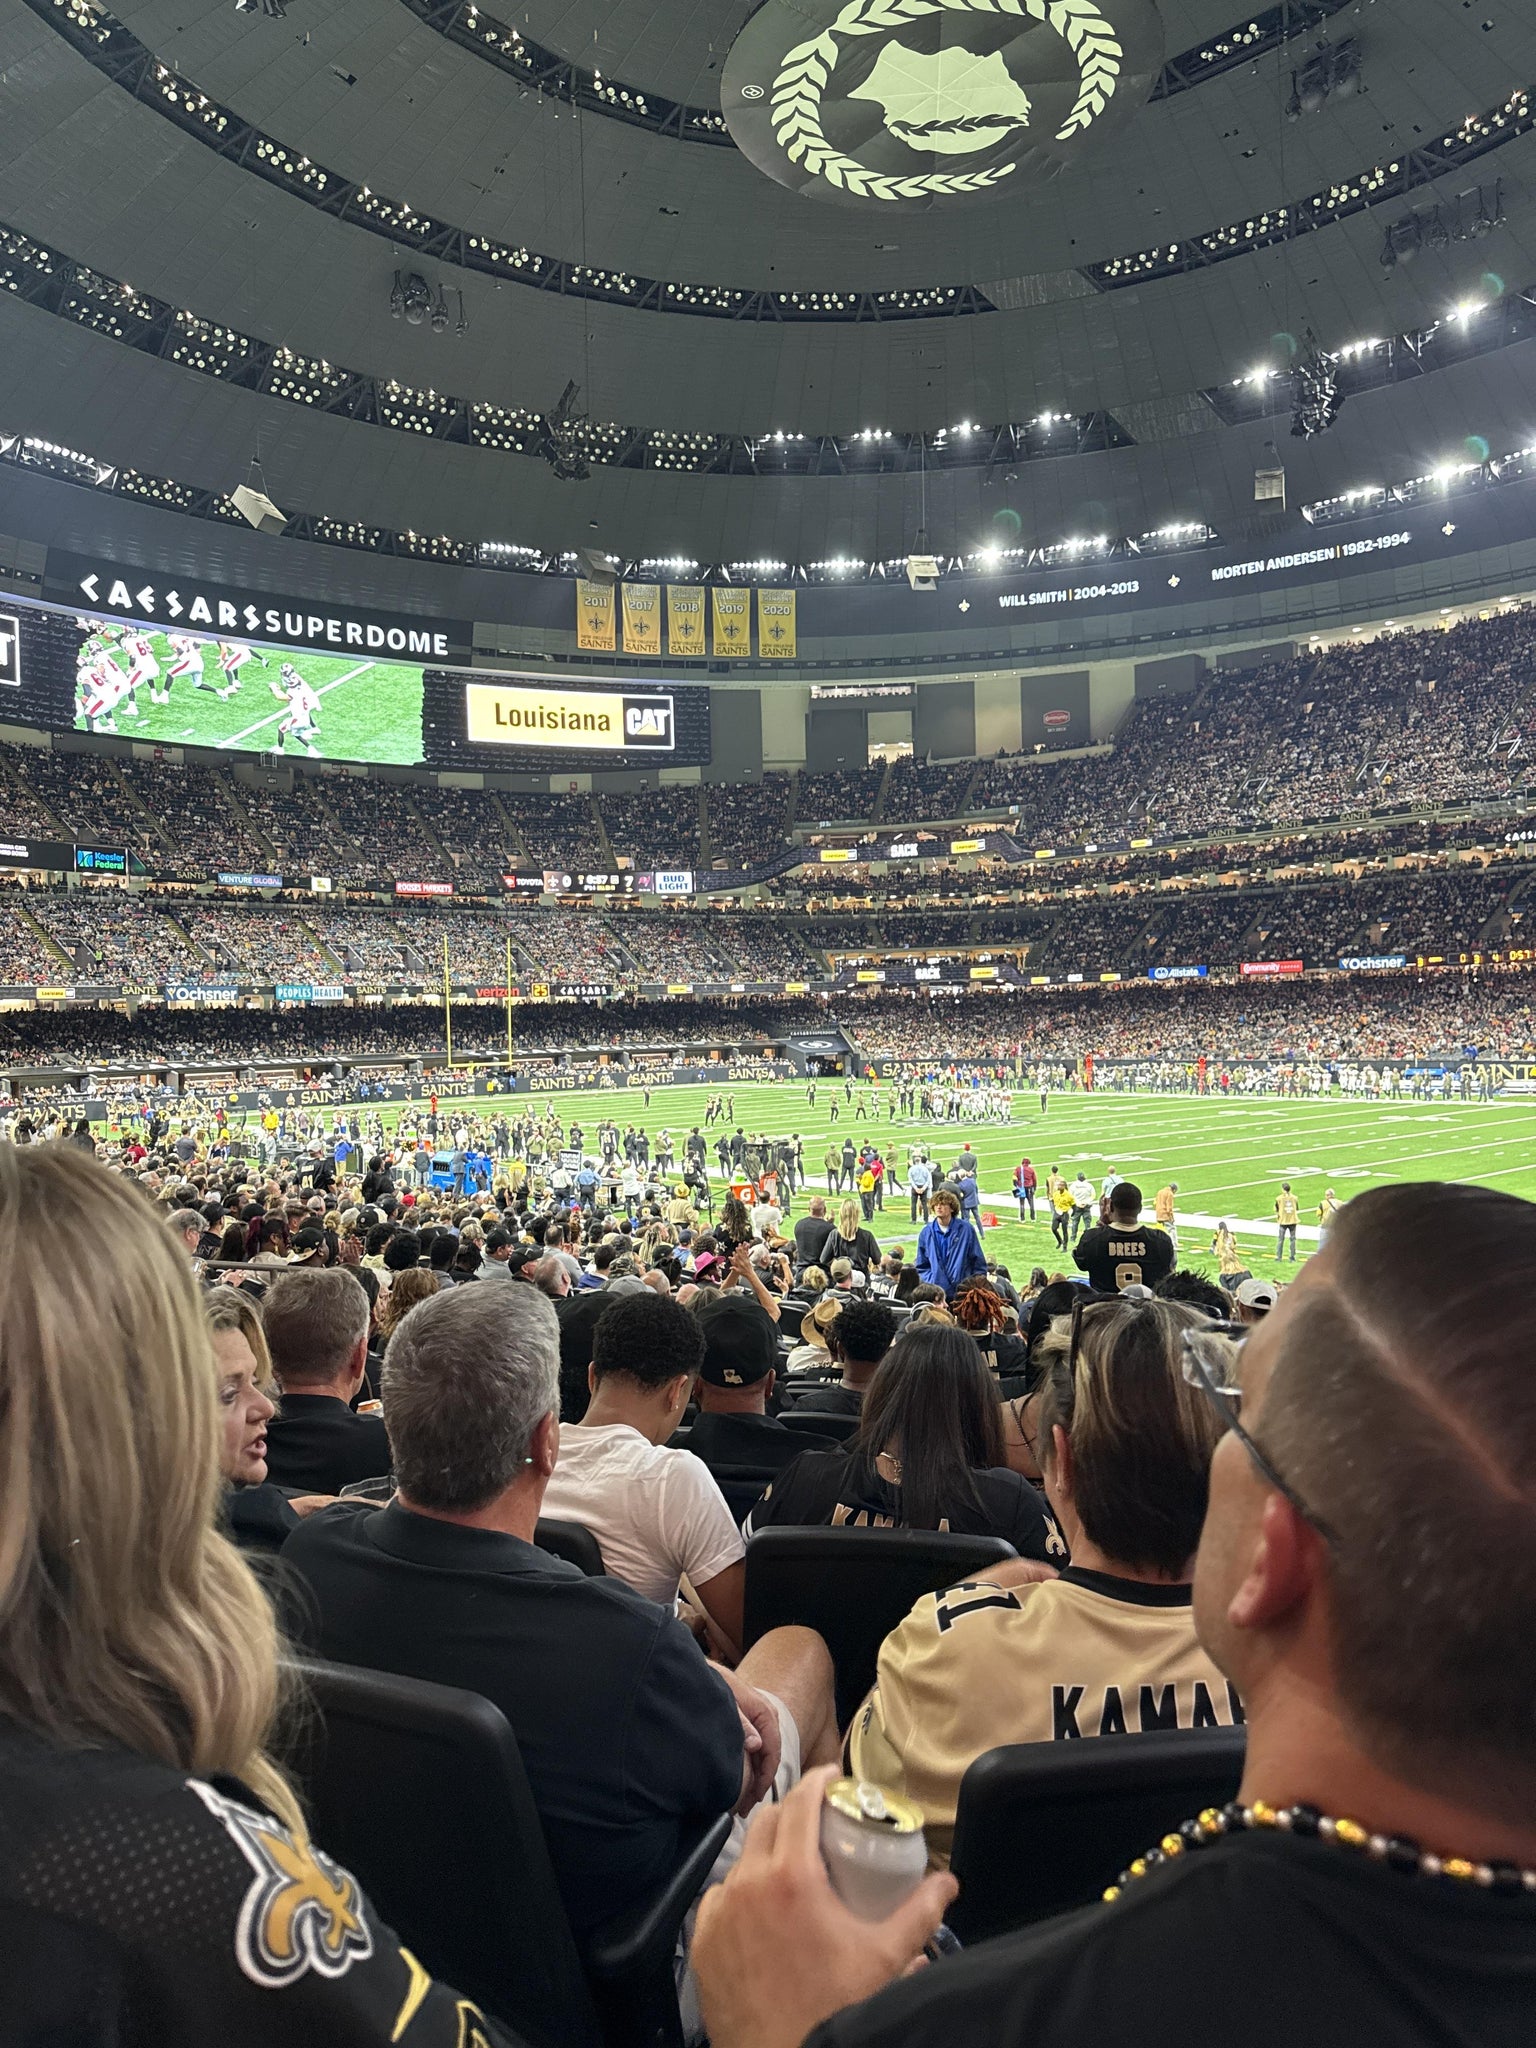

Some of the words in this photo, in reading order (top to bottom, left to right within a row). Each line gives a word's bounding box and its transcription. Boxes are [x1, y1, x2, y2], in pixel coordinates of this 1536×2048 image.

[1211, 560, 1265, 581] MORTEN
[1266, 547, 1335, 571] ANDERSEN
[1342, 531, 1411, 557] 1982-1994
[999, 594, 1028, 607] WILL
[1029, 591, 1067, 605] SMITH
[1074, 580, 1140, 600] 2004-2013
[584, 597, 608, 608] 2011
[629, 600, 654, 611] 2017
[673, 602, 699, 612] 2018
[80, 574, 260, 631] CAESARS
[265, 609, 449, 656] SUPERDOME
[719, 604, 744, 615] 2019
[763, 606, 791, 616] 2020
[580, 639, 613, 650] SAINTS
[625, 643, 658, 653] SAINTS
[671, 645, 703, 654] SAINTS
[716, 646, 748, 656] SAINTS
[761, 647, 794, 657] SAINTS
[495, 702, 611, 731] Louisiana
[626, 708, 669, 735] CAT
[1411, 802, 1444, 813] SAINTS
[1340, 811, 1371, 822] SAINTS
[94, 851, 124, 861] Keesler
[95, 860, 124, 870] Federal
[176, 871, 207, 880] SAINTS
[219, 875, 252, 885] VENTURE
[253, 876, 281, 885] GLOBAL
[562, 874, 572, 888] 0
[338, 879, 366, 888] SAINTS
[516, 878, 544, 886] TOYOTA
[624, 875, 634, 888] 7
[659, 883, 689, 891] LIGHT
[459, 885, 485, 893] SAINTS
[1349, 957, 1403, 970] Ochsner
[1168, 967, 1200, 977] Allstate
[122, 986, 158, 995] SAINTS
[176, 987, 237, 1000] Ochsner
[278, 987, 311, 998] PEOPLES
[314, 987, 342, 997] HEALTH
[356, 986, 387, 994] SAINTS
[475, 986, 520, 997] verizon
[533, 985, 548, 997] 25
[560, 986, 607, 995] CAESARS
[613, 984, 639, 993] SAINTS
[728, 1067, 769, 1080] SAINTS
[530, 1077, 575, 1090] SAINTS
[421, 1082, 467, 1097] SAINTS
[301, 1089, 352, 1104] SAINS
[1108, 1242, 1146, 1257] BREES
